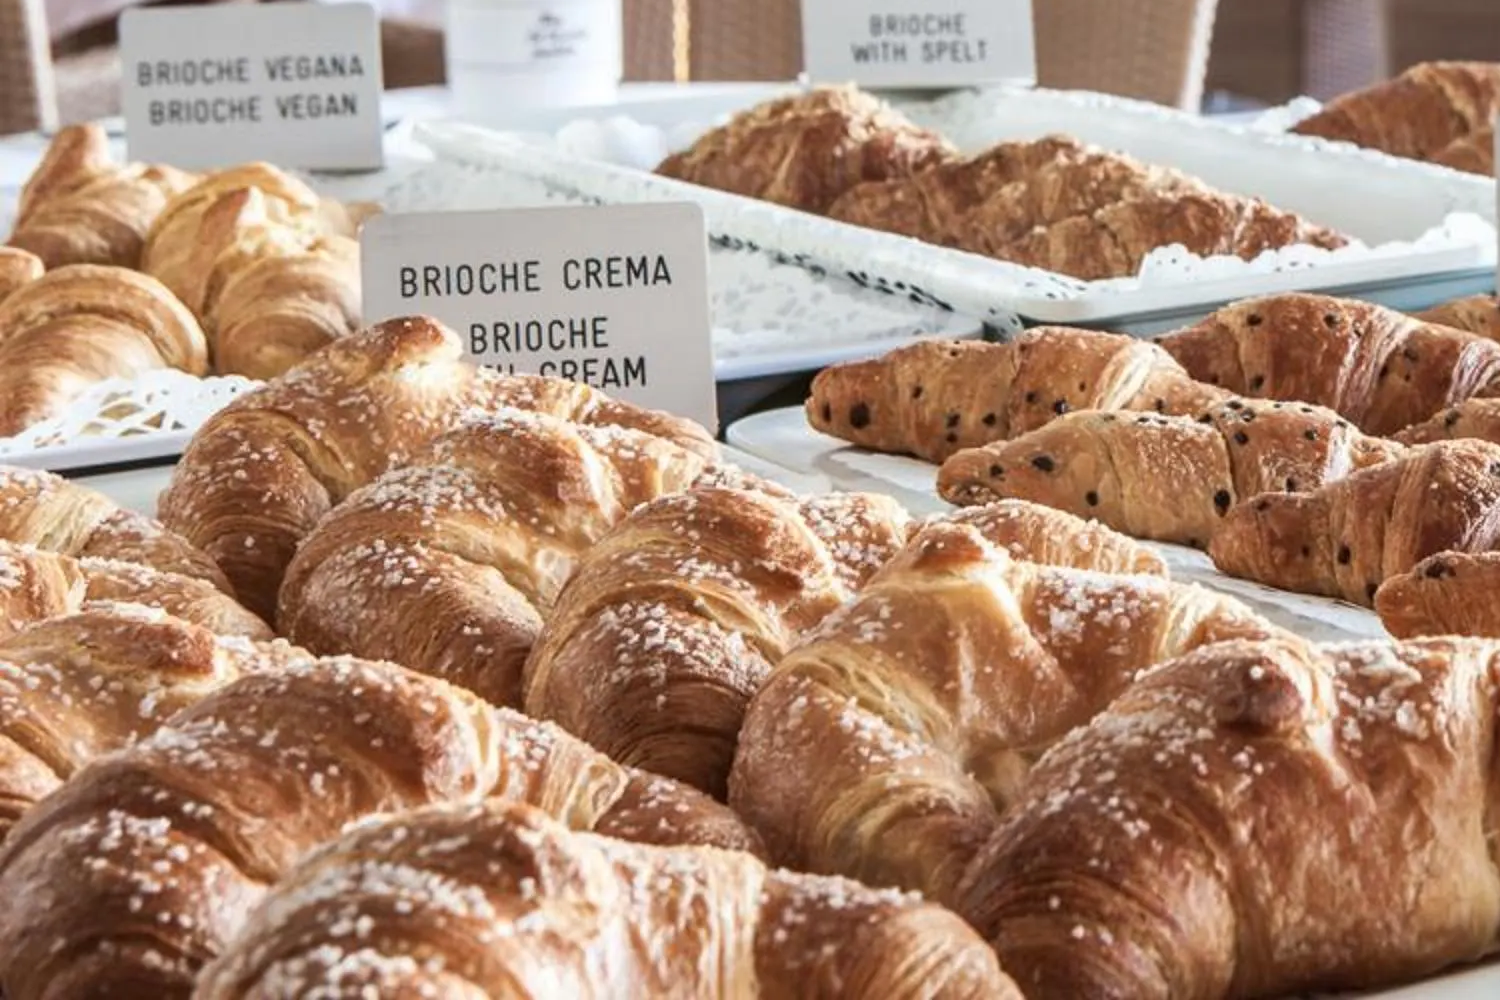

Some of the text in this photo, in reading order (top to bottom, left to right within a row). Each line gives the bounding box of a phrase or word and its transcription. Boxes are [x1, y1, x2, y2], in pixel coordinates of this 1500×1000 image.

[868, 13, 967, 37] BRIOCHE
[850, 39, 988, 63] WITH SPELT
[136, 54, 365, 86] BRIOCHE VEGANA
[148, 94, 359, 126] BRIOCHE VEGAN
[399, 253, 673, 300] BRIOCHE CREMA
[469, 315, 611, 356] BRIOCHE
